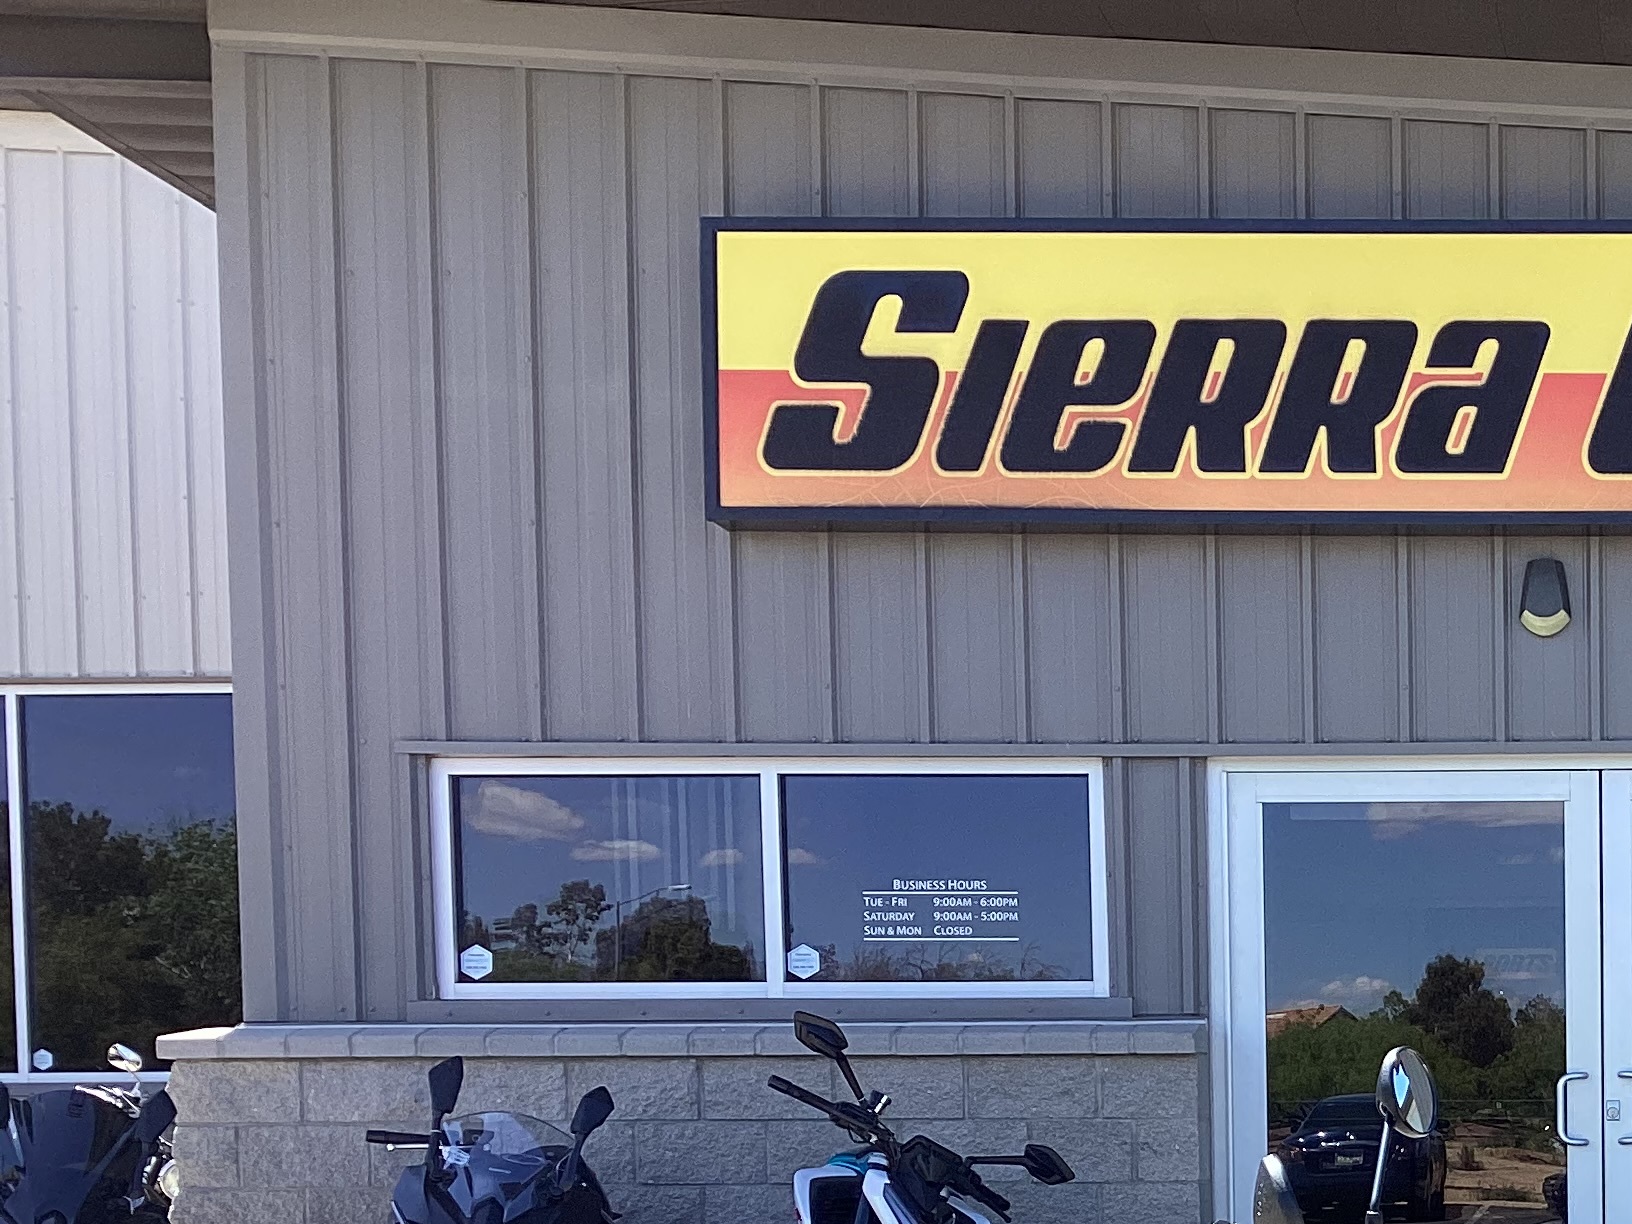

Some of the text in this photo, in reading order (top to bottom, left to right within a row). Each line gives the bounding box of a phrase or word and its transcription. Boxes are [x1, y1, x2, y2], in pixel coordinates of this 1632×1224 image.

[760, 269, 1552, 473] Sierra
[893, 879, 988, 890] BUSINESS HOURS
[863, 897, 884, 907] TUE
[891, 897, 908, 907] FRI
[932, 897, 972, 907] 9:00AM
[980, 897, 1018, 907] 6:00PM
[863, 911, 916, 922] SATURDAY
[933, 911, 972, 921] 9:00AM
[980, 911, 1019, 921] 5:00PM
[863, 925, 973, 936] SUN & MON CLOSED
